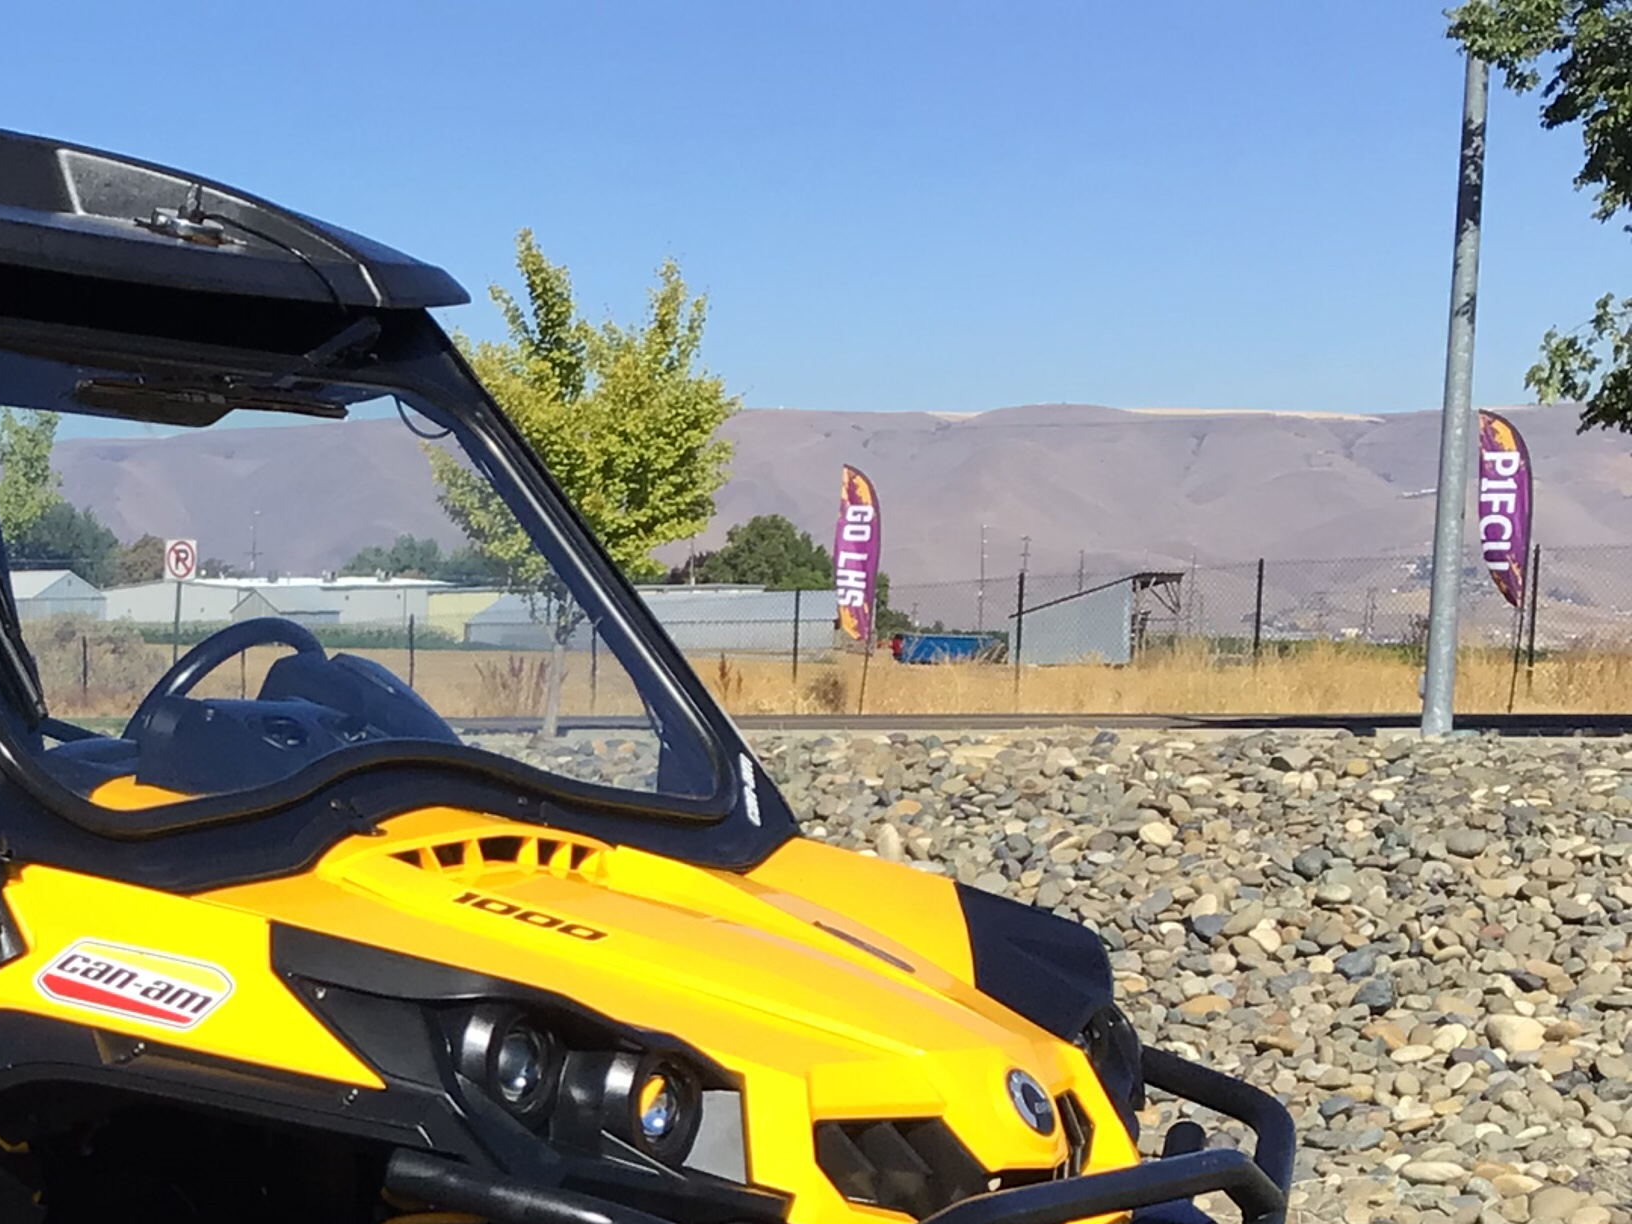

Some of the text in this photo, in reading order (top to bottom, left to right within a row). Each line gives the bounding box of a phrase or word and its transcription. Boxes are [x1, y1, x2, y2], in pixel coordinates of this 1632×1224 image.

[1479, 451, 1520, 571] P1FCU
[836, 505, 874, 607] GO LHS
[452, 892, 609, 941] 1000
[56, 954, 213, 1014] can-am
